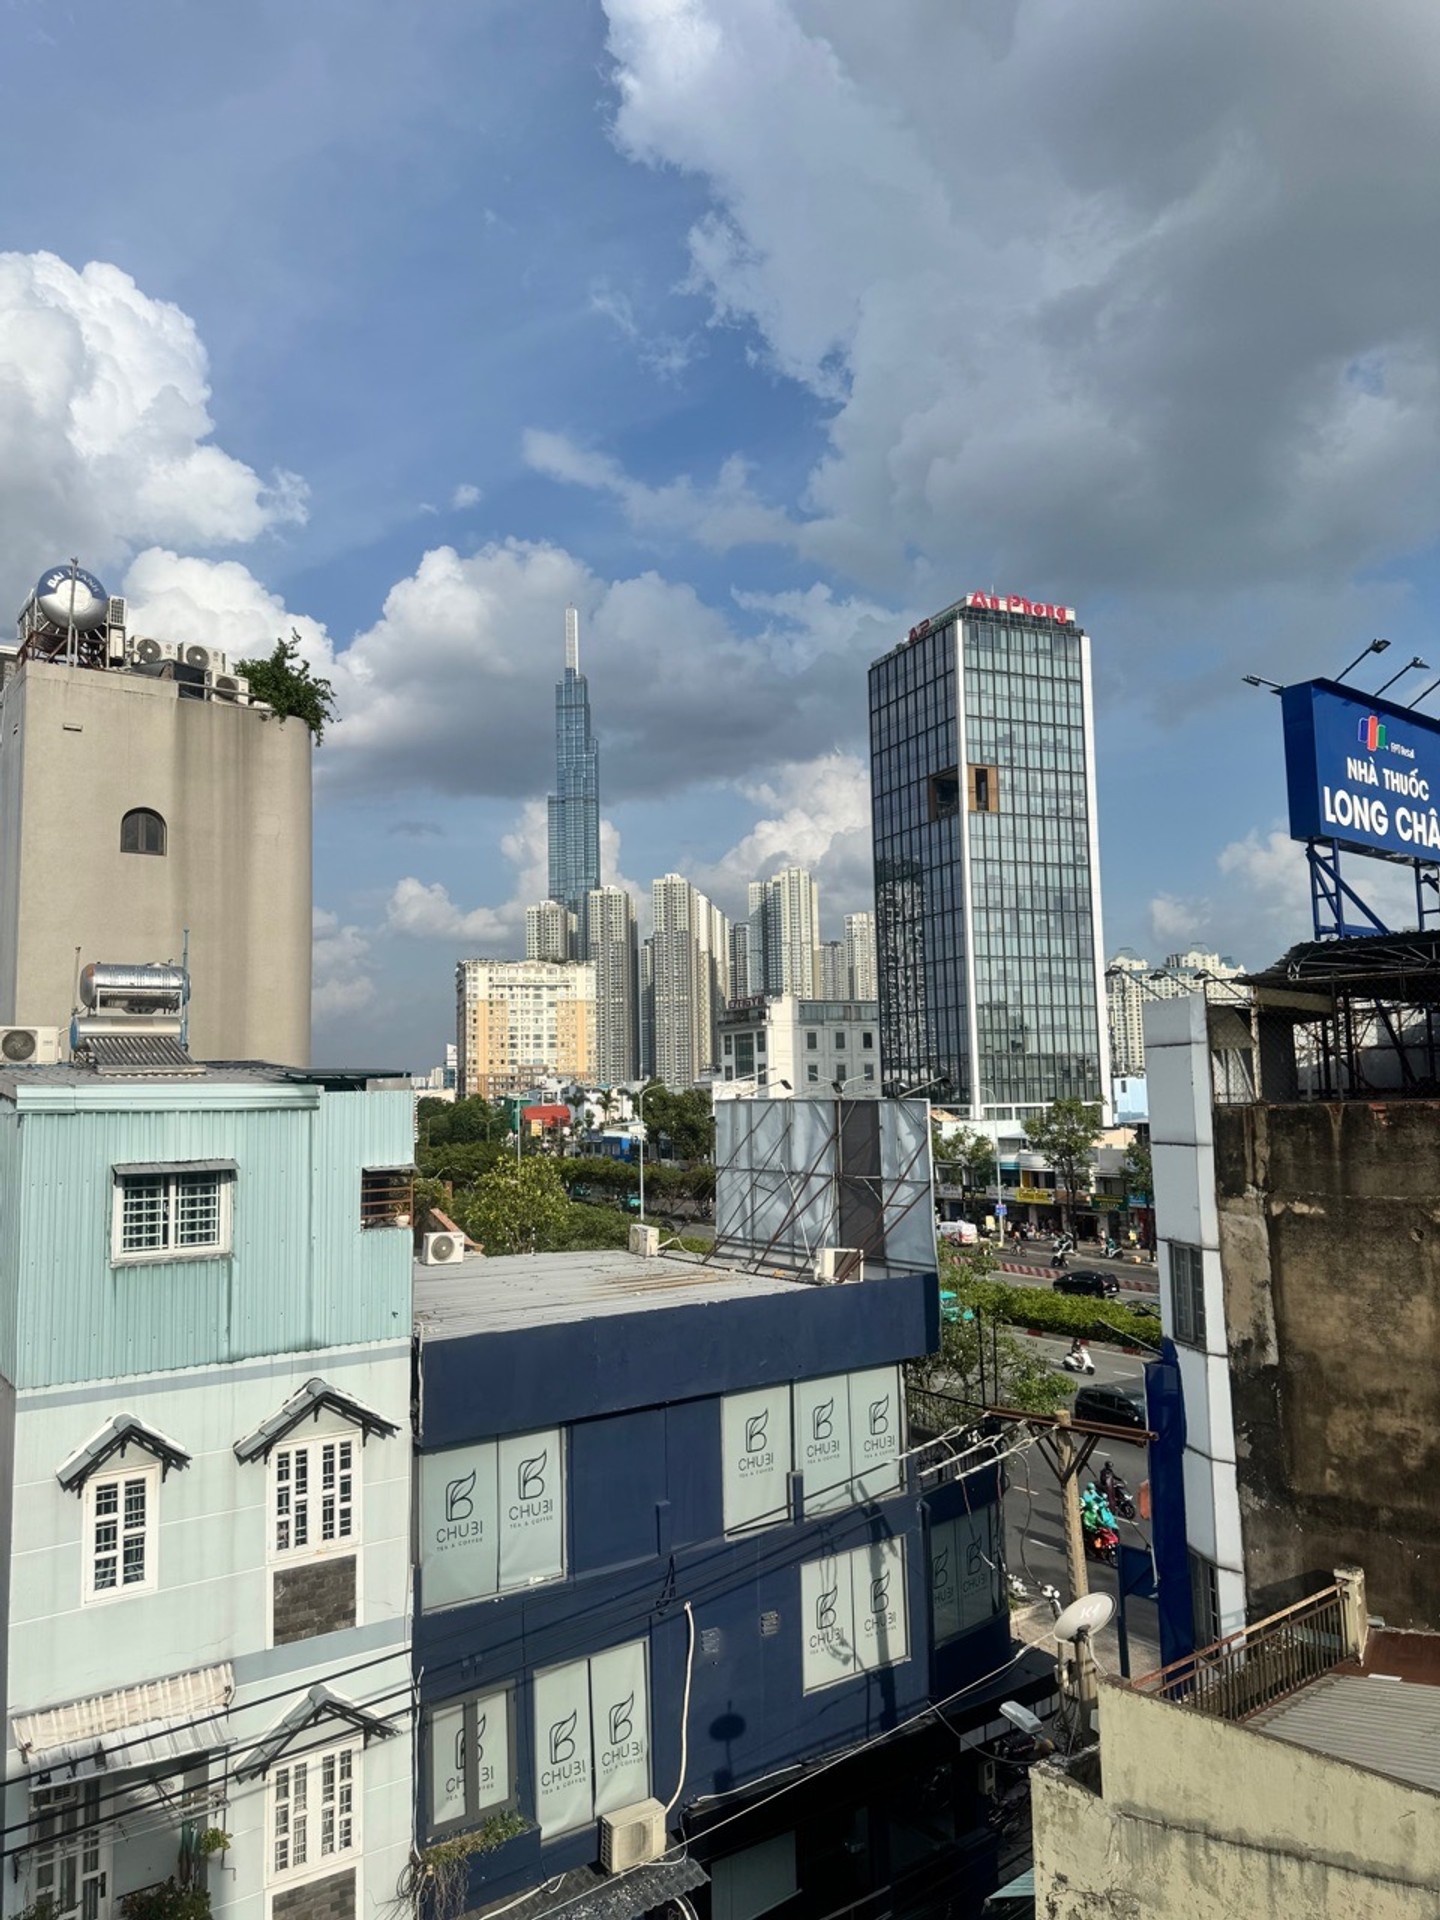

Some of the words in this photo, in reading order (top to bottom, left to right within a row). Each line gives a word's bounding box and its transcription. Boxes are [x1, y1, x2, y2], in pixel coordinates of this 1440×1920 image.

[972, 589, 1000, 609] An
[1006, 593, 1067, 624] Phong
[1346, 757, 1378, 786] NHÀ
[1382, 767, 1430, 801] THUỐC
[1323, 786, 1389, 836] LONG
